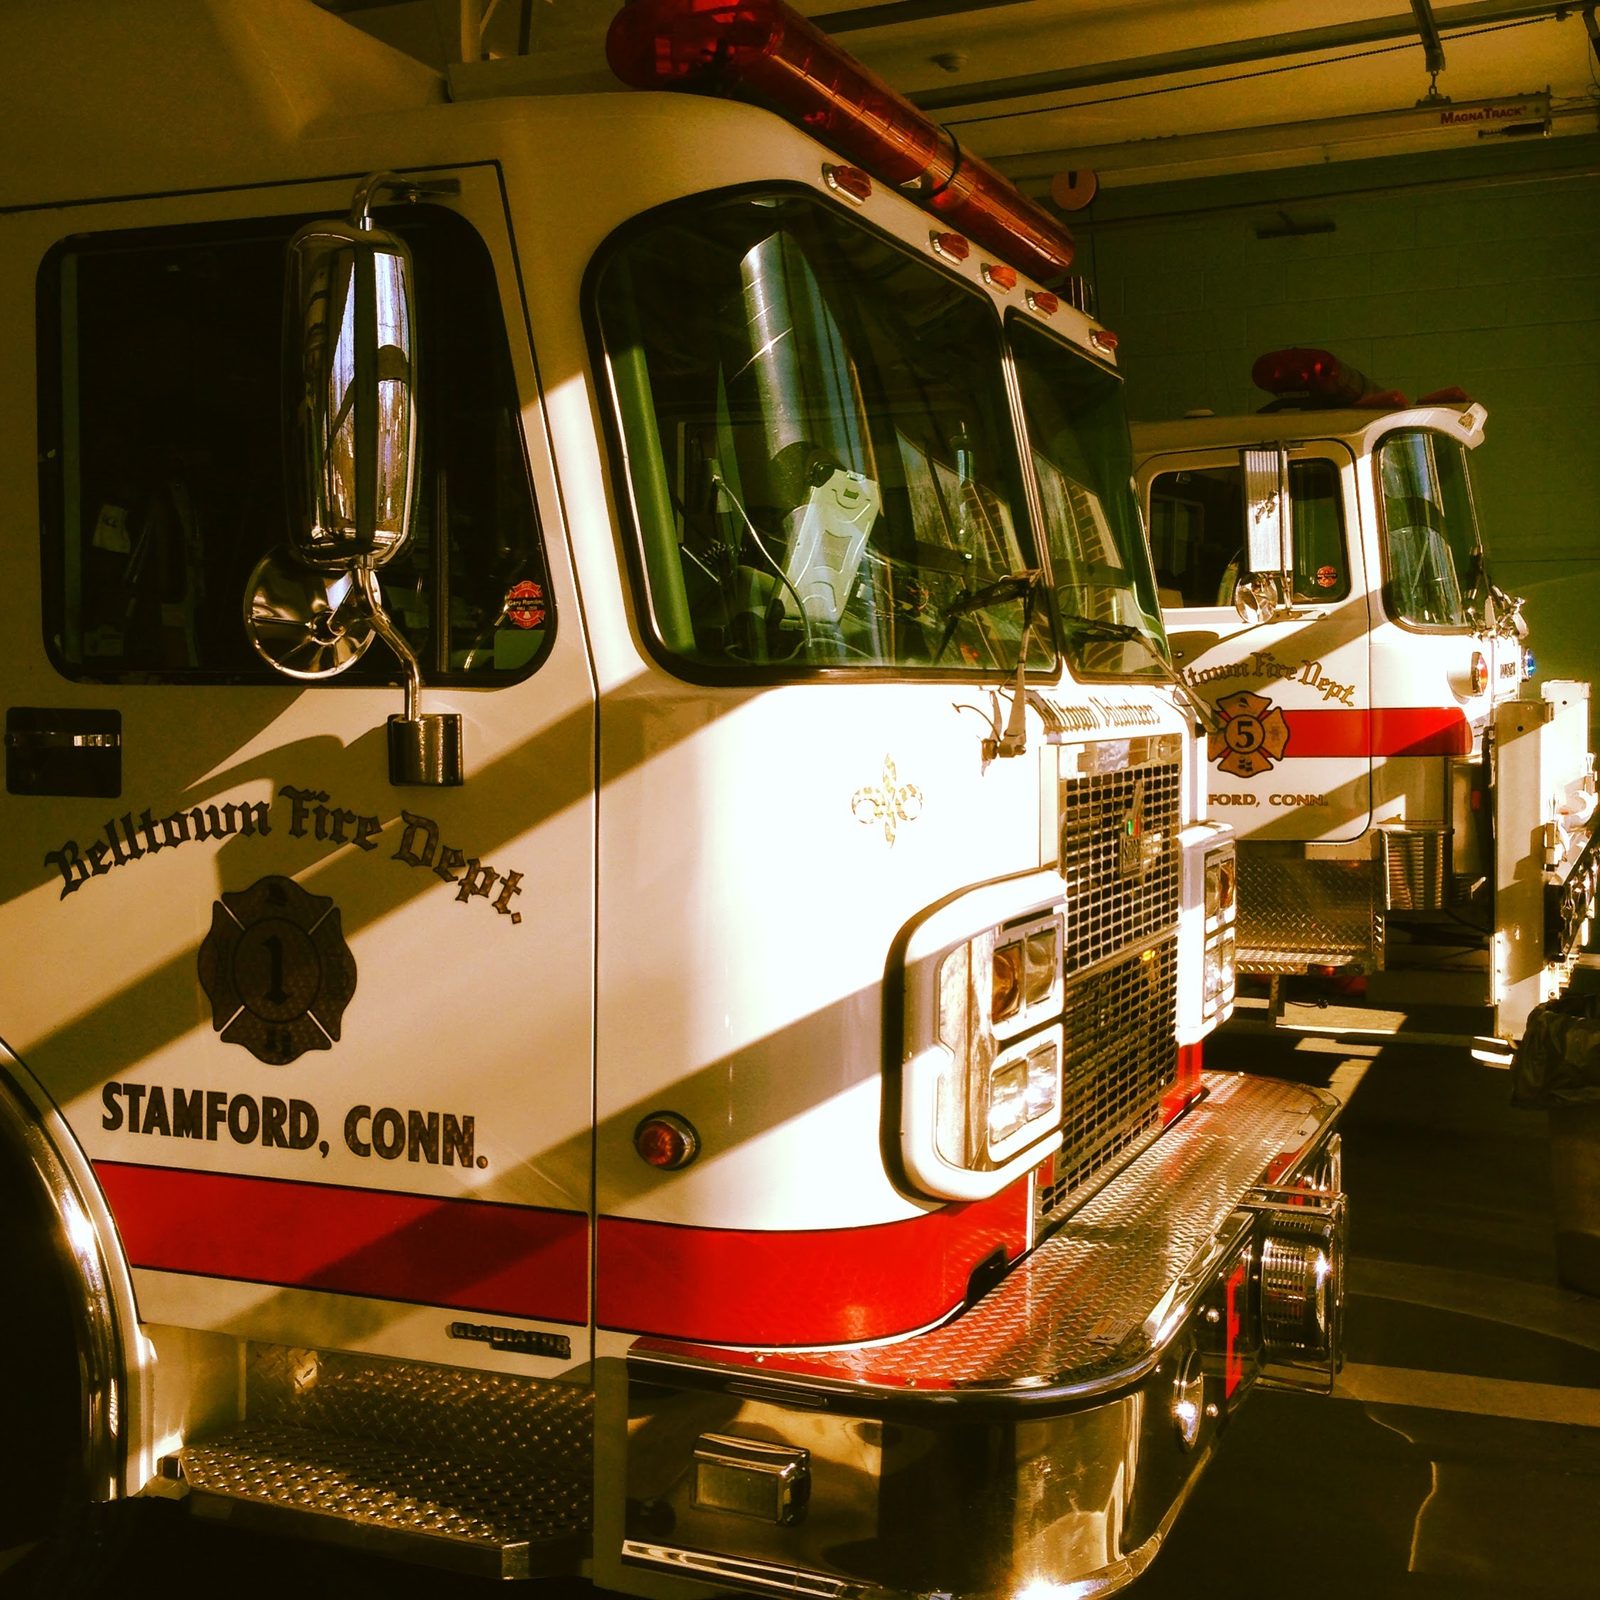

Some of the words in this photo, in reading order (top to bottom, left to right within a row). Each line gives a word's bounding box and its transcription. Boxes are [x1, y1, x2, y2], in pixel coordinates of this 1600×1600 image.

[1179, 662, 1249, 688] ltown
[1250, 652, 1298, 681] Fire
[1298, 659, 1356, 707] Dept.
[1235, 720, 1255, 748] 5
[1207, 793, 1261, 808] FORD,
[1268, 793, 1329, 807] CONN.
[44, 800, 273, 901] Belltown
[279, 785, 384, 852] Fire
[391, 809, 525, 925] Dept.
[262, 935, 290, 1005] 1
[102, 1081, 330, 1159] STAMFORD,
[343, 1104, 489, 1169] CONN.
